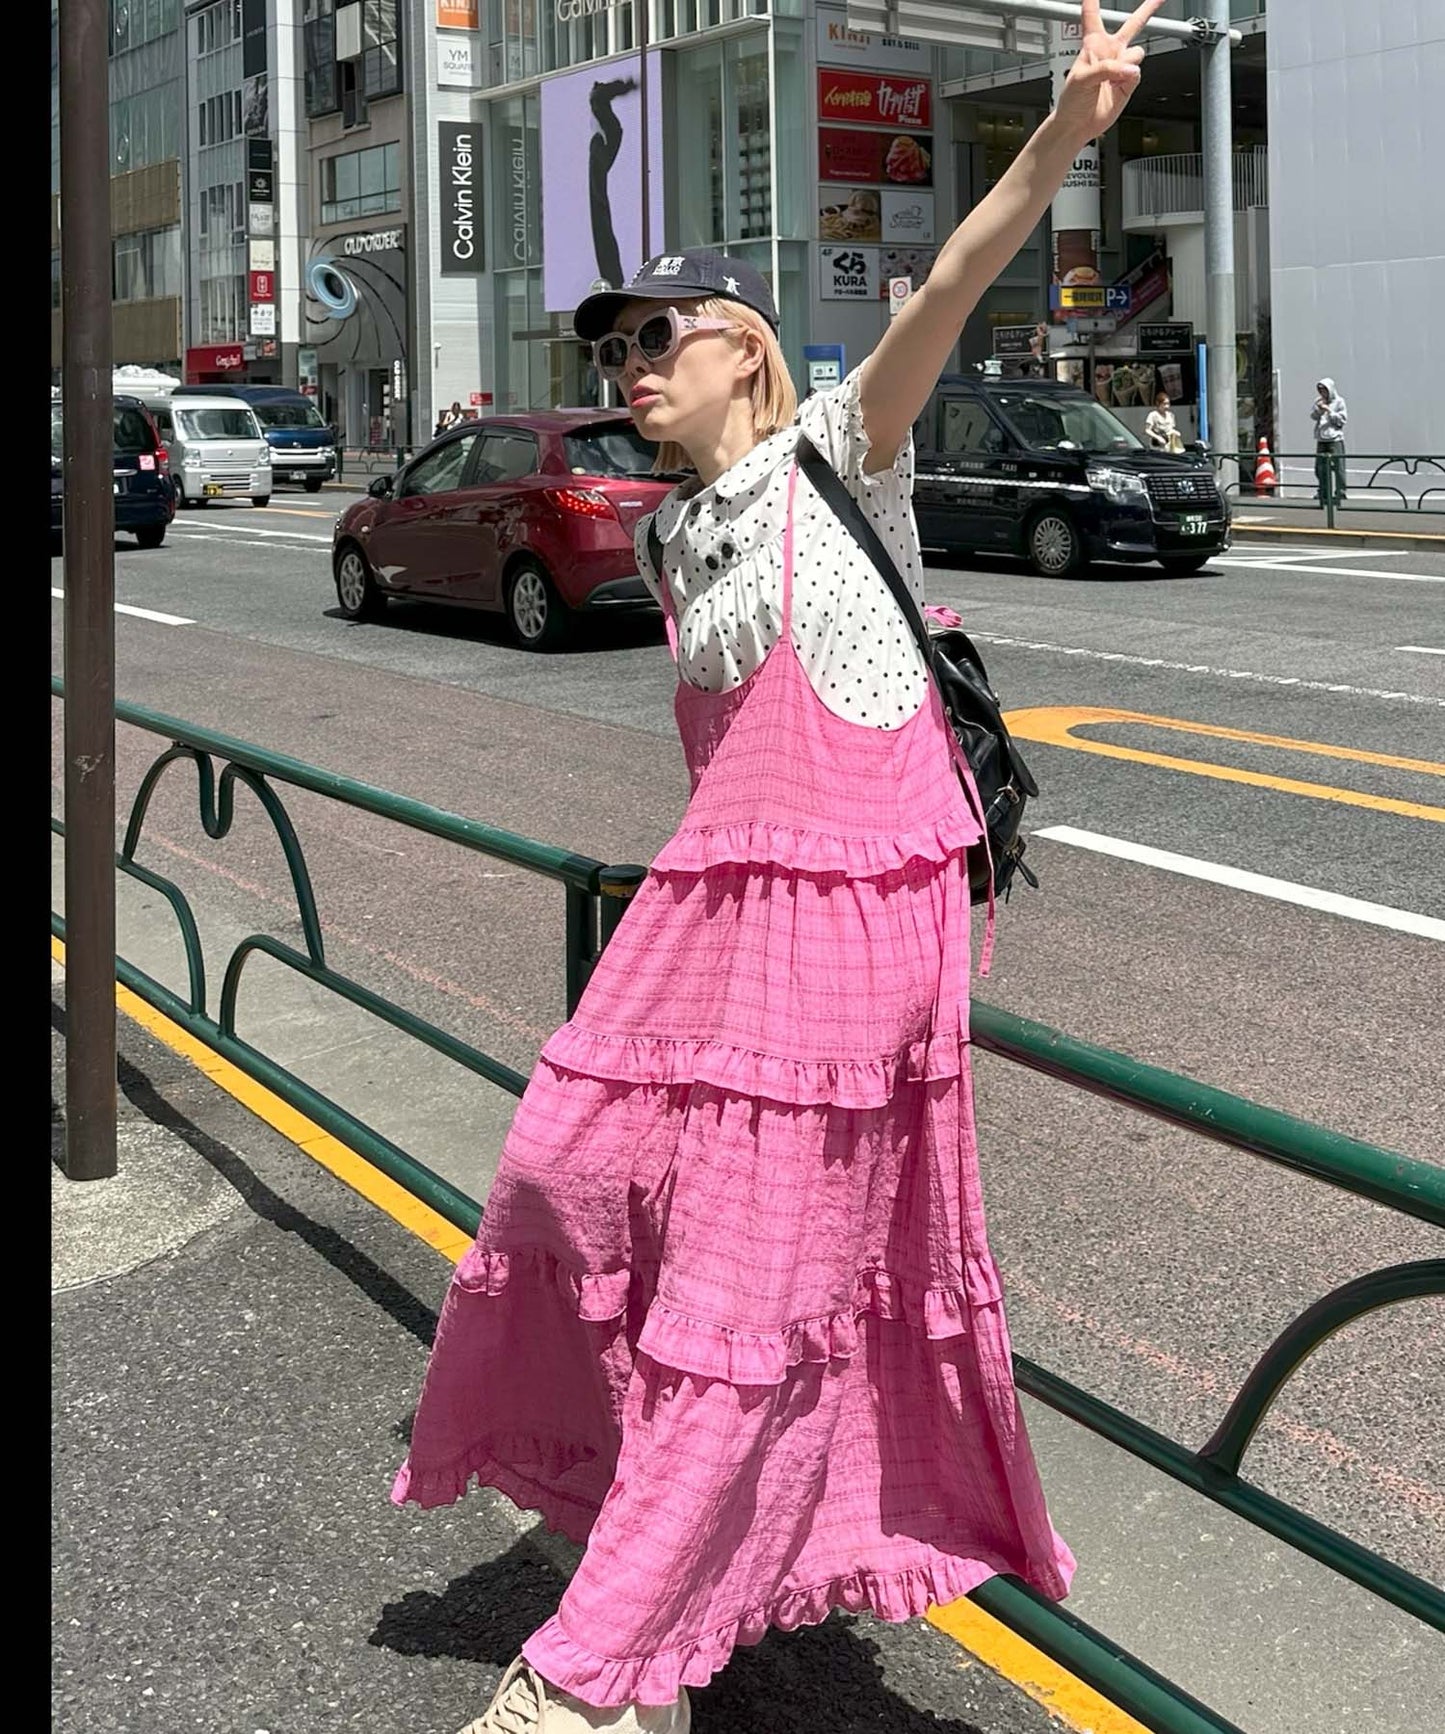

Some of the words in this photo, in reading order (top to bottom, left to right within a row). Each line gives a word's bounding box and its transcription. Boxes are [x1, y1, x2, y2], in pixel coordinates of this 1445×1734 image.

[449, 49, 468, 61] YM
[452, 134, 472, 185] Klein
[453, 190, 474, 260] Calvin
[833, 251, 867, 275] くら
[833, 275, 868, 287] KURA
[1106, 288, 1117, 307] P
[1001, 463, 1018, 473] TAXI
